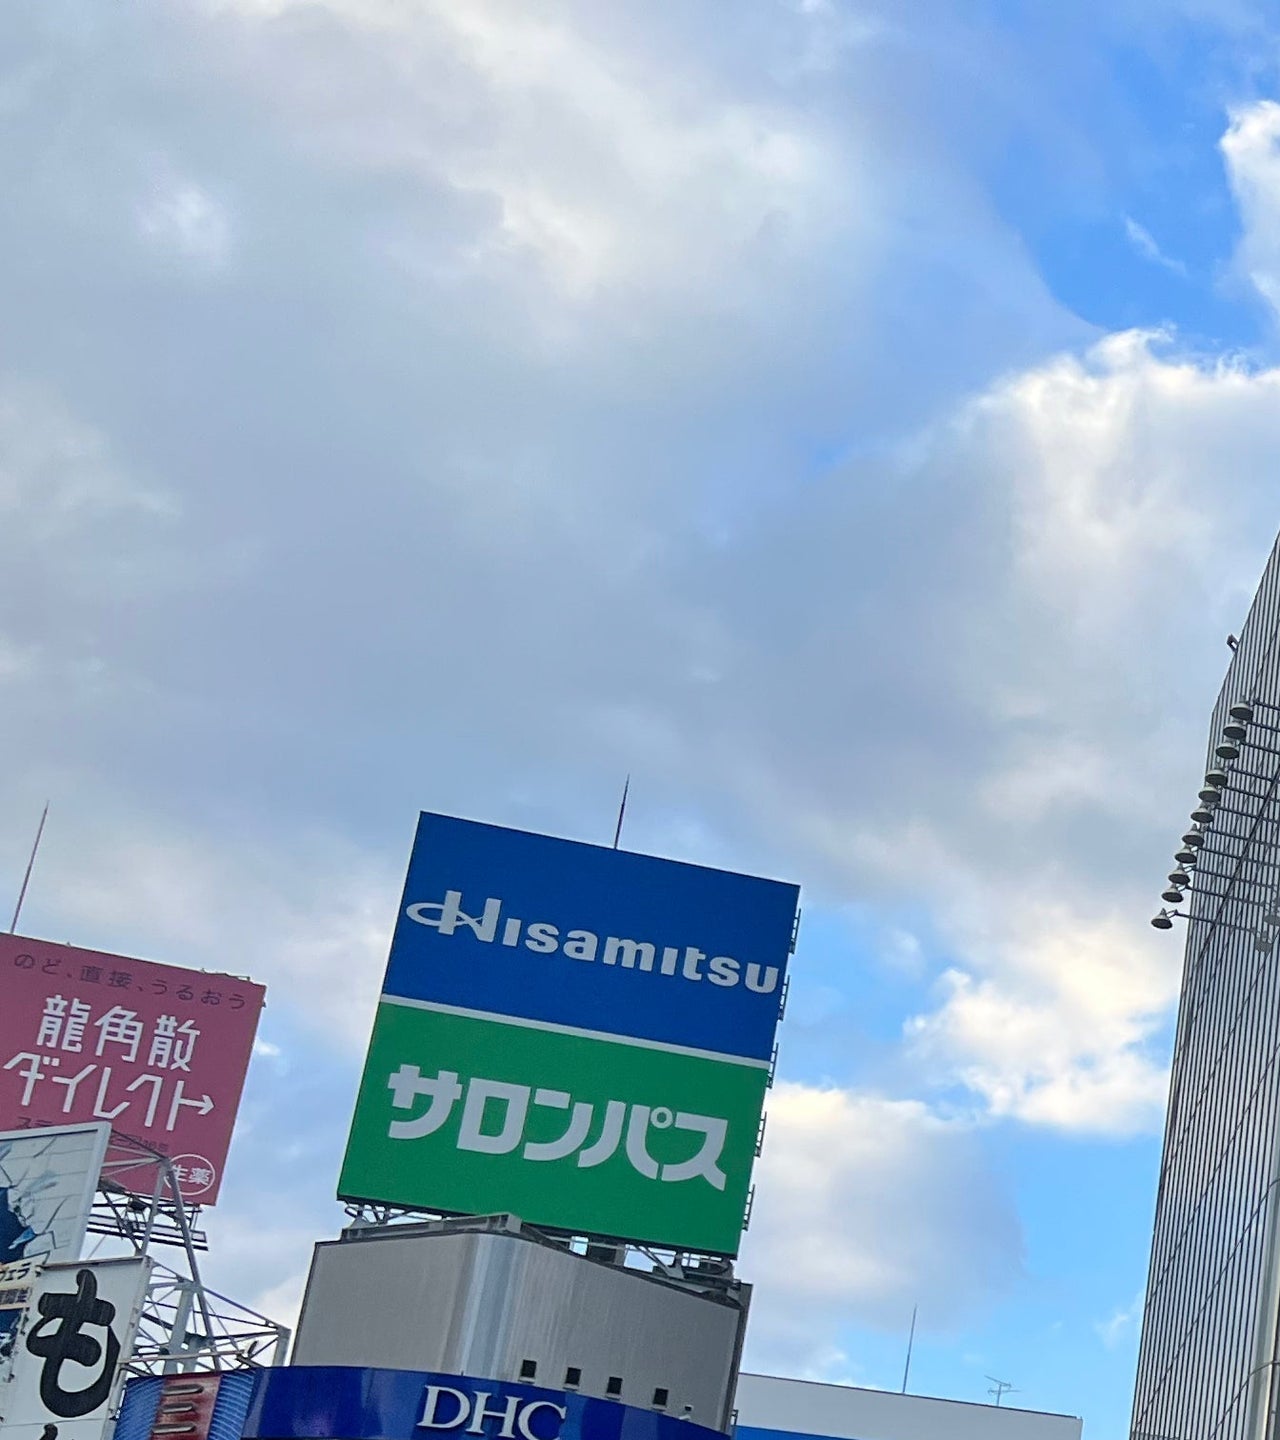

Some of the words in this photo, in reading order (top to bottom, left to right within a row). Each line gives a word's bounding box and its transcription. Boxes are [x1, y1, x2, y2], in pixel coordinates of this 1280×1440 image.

[14, 953, 245, 1011] のど、直接、うるおう
[36, 995, 201, 1072] 龍角散
[387, 1064, 728, 1192] サロンパス
